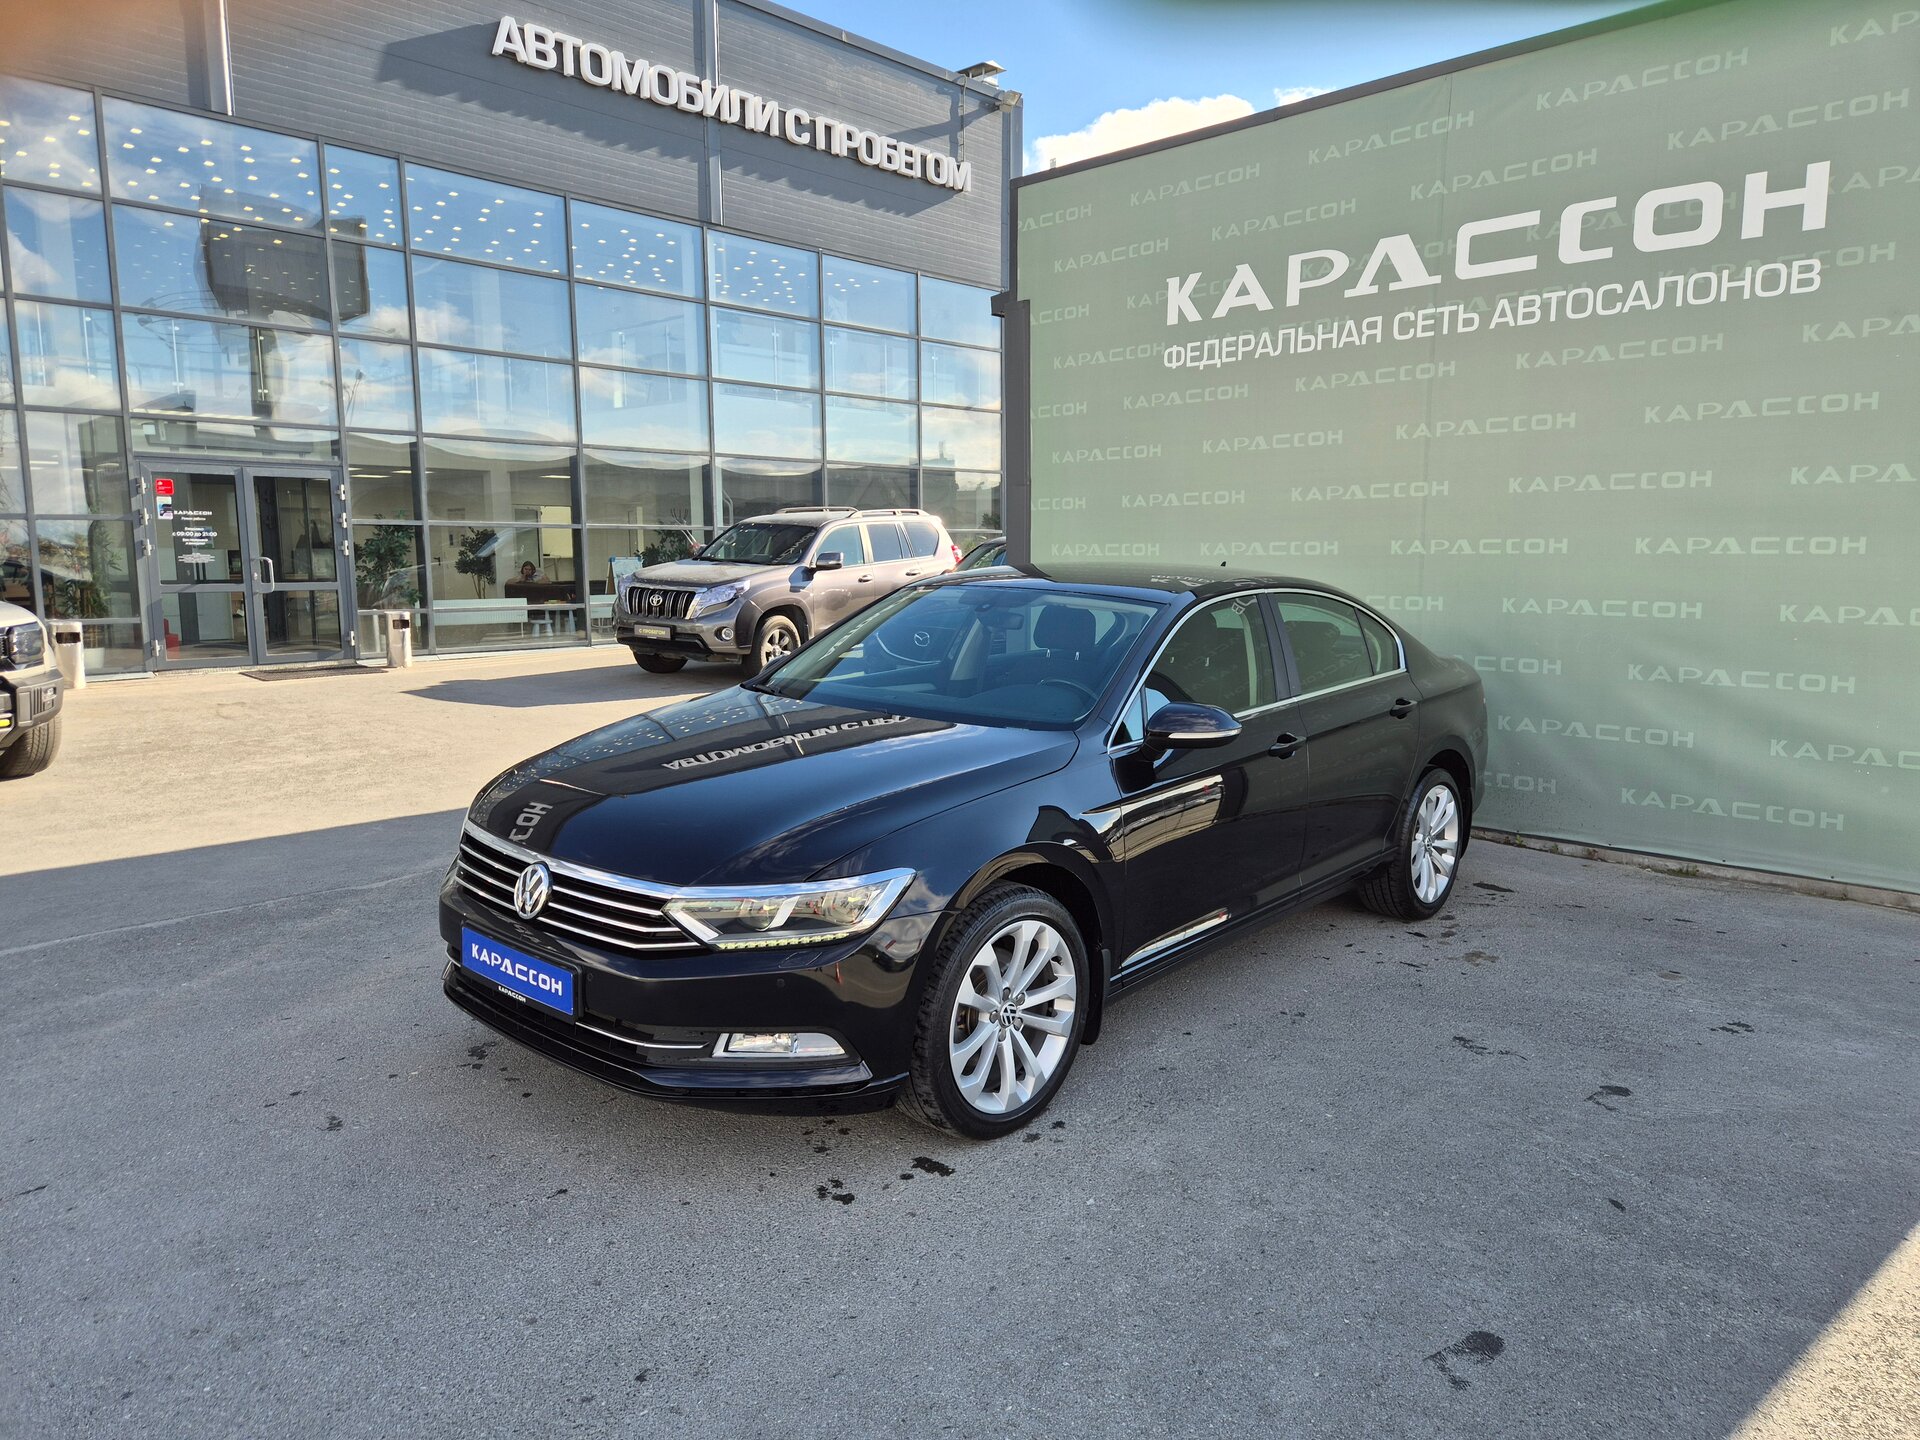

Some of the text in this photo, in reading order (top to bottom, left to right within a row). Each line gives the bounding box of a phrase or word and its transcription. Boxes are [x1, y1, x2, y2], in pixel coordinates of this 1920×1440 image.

[1536, 46, 1749, 111] КАРАССОН
[491, 15, 972, 192] АВТОМОБИЛИ С ПРОБЕГОМ
[1667, 88, 1910, 150] КАРАССОН
[1308, 110, 1475, 165] КАРАССОН
[1130, 162, 1260, 207] КАРАССОН
[1410, 148, 1598, 201] КАРАССОН
[1211, 197, 1356, 241] КАРАССОН
[1054, 237, 1169, 274] КАРАССОН
[1165, 160, 1831, 326] КАРАССОН
[1163, 258, 1822, 370] ФЕДЕРАЛЬНАЯ СЕТЬ АВТОСАЛОНОВ
[1516, 333, 1724, 371] КАРАССОН
[1295, 360, 1456, 393] КАРАССОН
[1123, 383, 1249, 411] КАРАССОН
[1644, 391, 1880, 424] КАРАССОН
[1202, 429, 1343, 454] КАРАССОН
[1396, 412, 1577, 440] КАРАССОН
[1051, 443, 1163, 464] КАРАССОН
[1121, 489, 1246, 508] КАРАССОН
[1291, 480, 1450, 502] КАРАССОН
[1508, 470, 1713, 494] КАРАССОН
[1051, 543, 1160, 558] КАРАССОН
[1200, 541, 1339, 556] КАРАССОН
[1390, 537, 1569, 555] КАРАССОН
[1635, 536, 1867, 555] КАРАССОН
[1502, 597, 1703, 620] КАРАССОН
[1627, 663, 1857, 694] КАРАССОН
[1497, 714, 1695, 749] КАРАССОН
[1620, 787, 1845, 831] КАРАССОН
[471, 943, 563, 997] КАРАССОН
